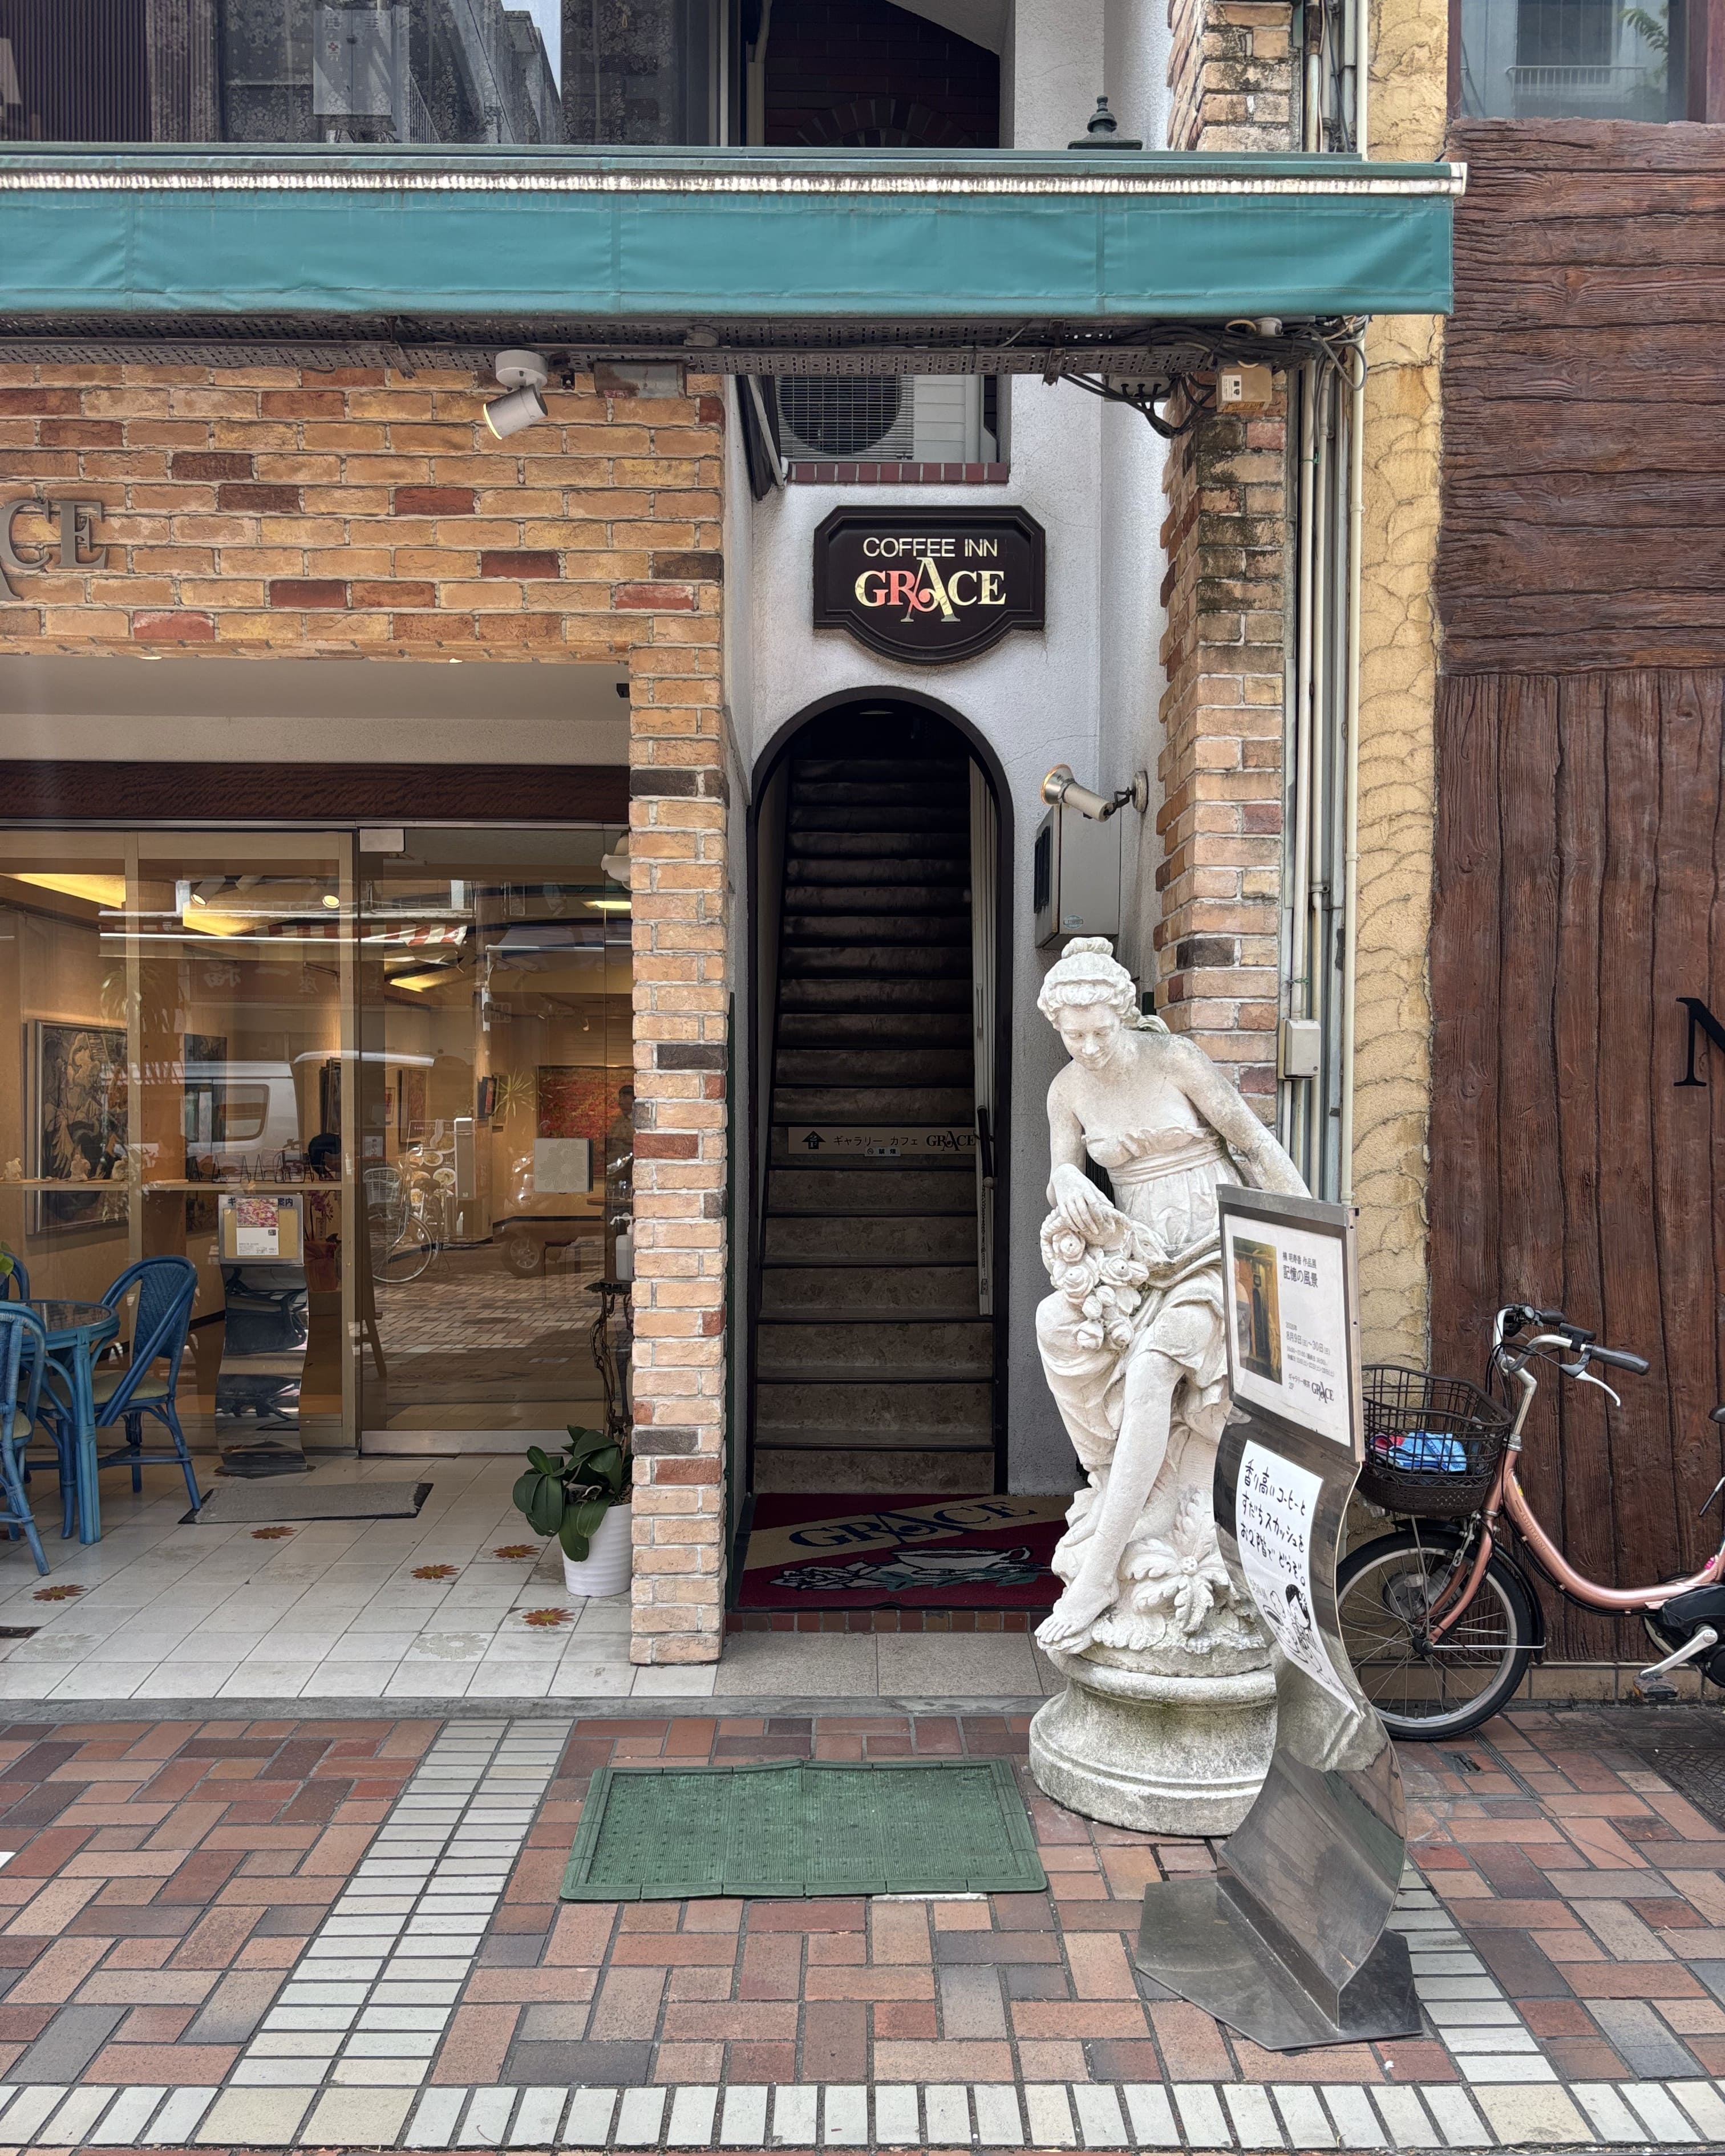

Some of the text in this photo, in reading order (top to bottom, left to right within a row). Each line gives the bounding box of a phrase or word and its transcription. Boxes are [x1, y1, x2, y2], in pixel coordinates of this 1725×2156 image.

[0, 500, 107, 600] CE
[863, 538, 998, 557] COFFEE INN
[855, 557, 1007, 622] GRACE
[833, 1130, 975, 1151] ギャラリー カフェ GRACE
[1283, 1265, 1318, 1288] 記憶の風景
[1311, 1381, 1334, 1404] GRACE
[1245, 1459, 1306, 1516] 香り高いコーヒーと
[788, 1500, 1037, 1547] GRACE
